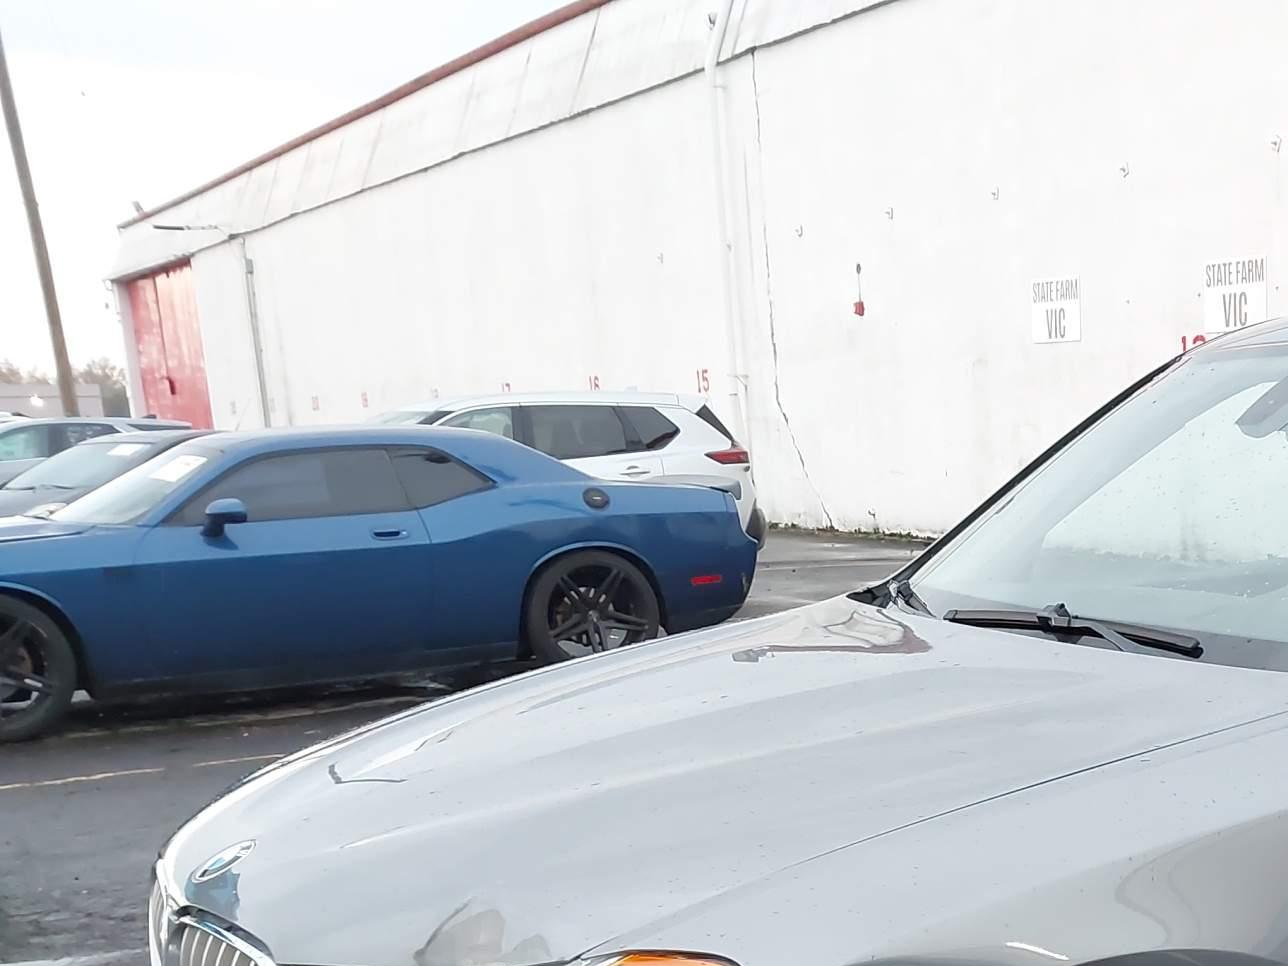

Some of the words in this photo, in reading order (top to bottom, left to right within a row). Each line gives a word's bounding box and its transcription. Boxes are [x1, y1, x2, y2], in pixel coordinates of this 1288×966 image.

[1205, 261, 1233, 288] STATE
[1235, 258, 1264, 285] FARM
[1032, 281, 1054, 304] STATE
[1055, 278, 1078, 302] FARM
[1045, 308, 1066, 340] VIC
[1222, 291, 1248, 328] VIC
[696, 369, 710, 393] 15
